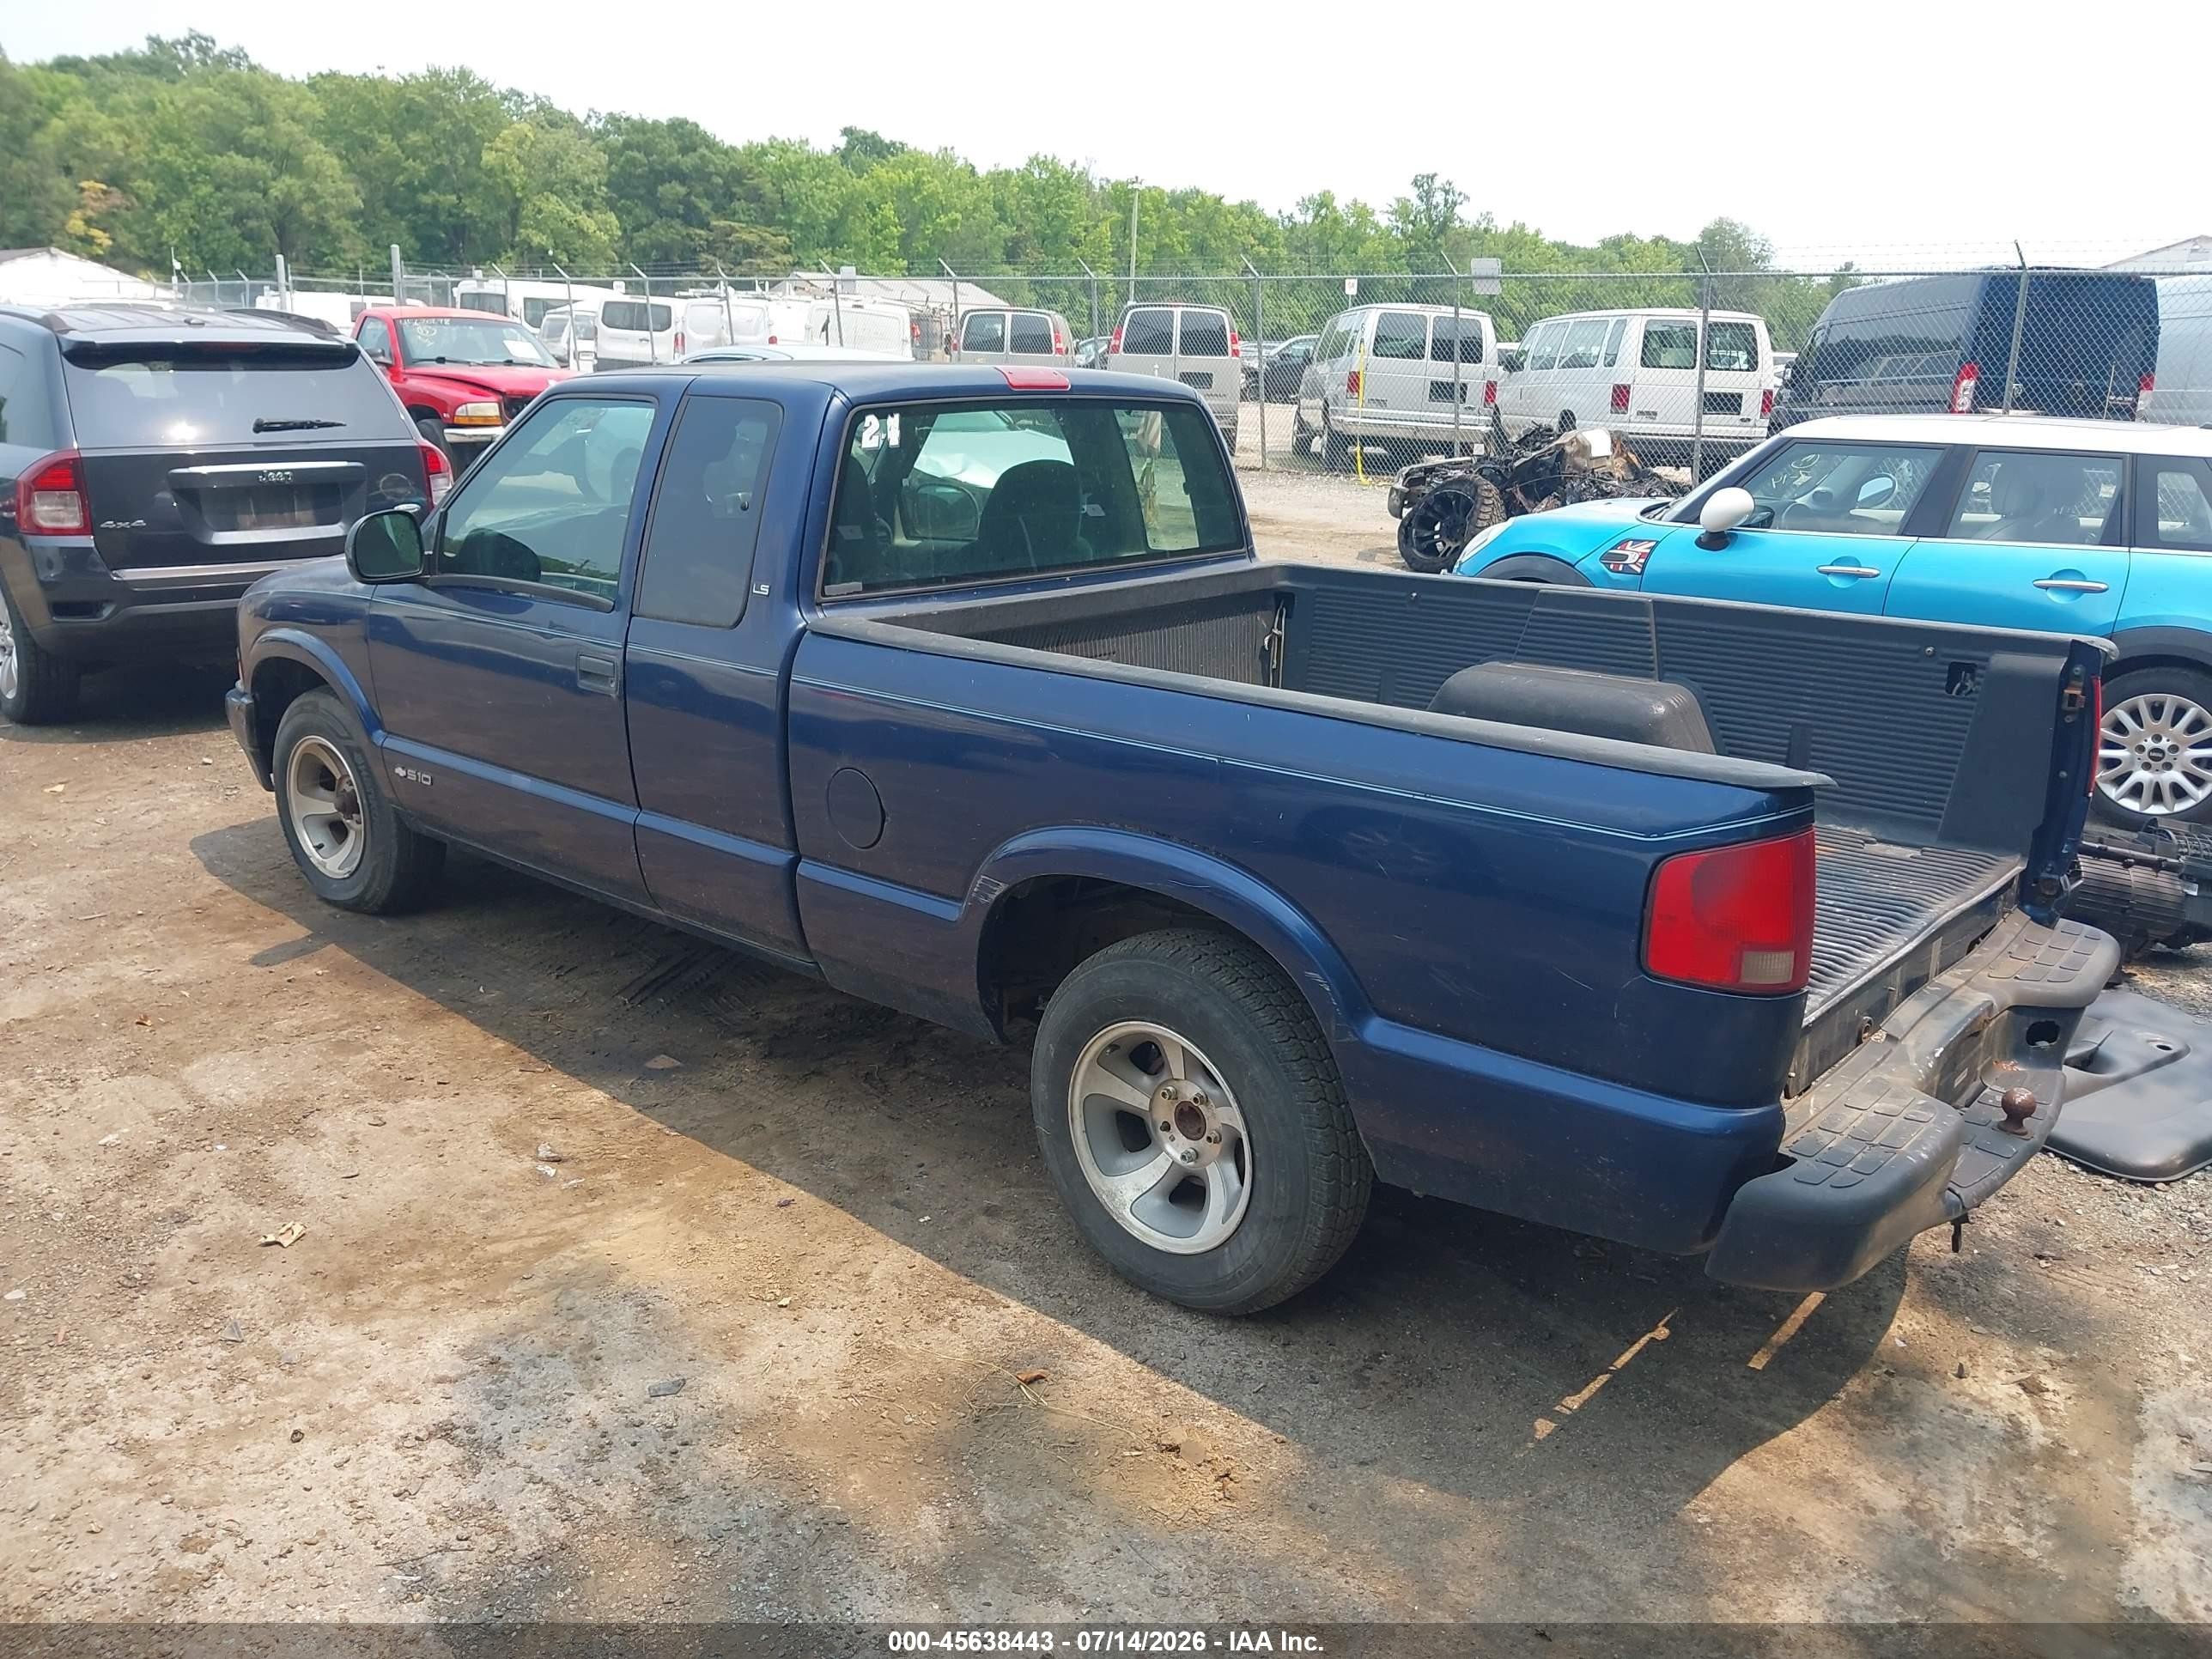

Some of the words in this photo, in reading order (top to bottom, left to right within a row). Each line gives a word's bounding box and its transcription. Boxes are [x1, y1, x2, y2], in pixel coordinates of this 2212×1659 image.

[258, 470, 293, 484] Jeep
[752, 583, 770, 596] LS
[407, 769, 432, 786] S10
